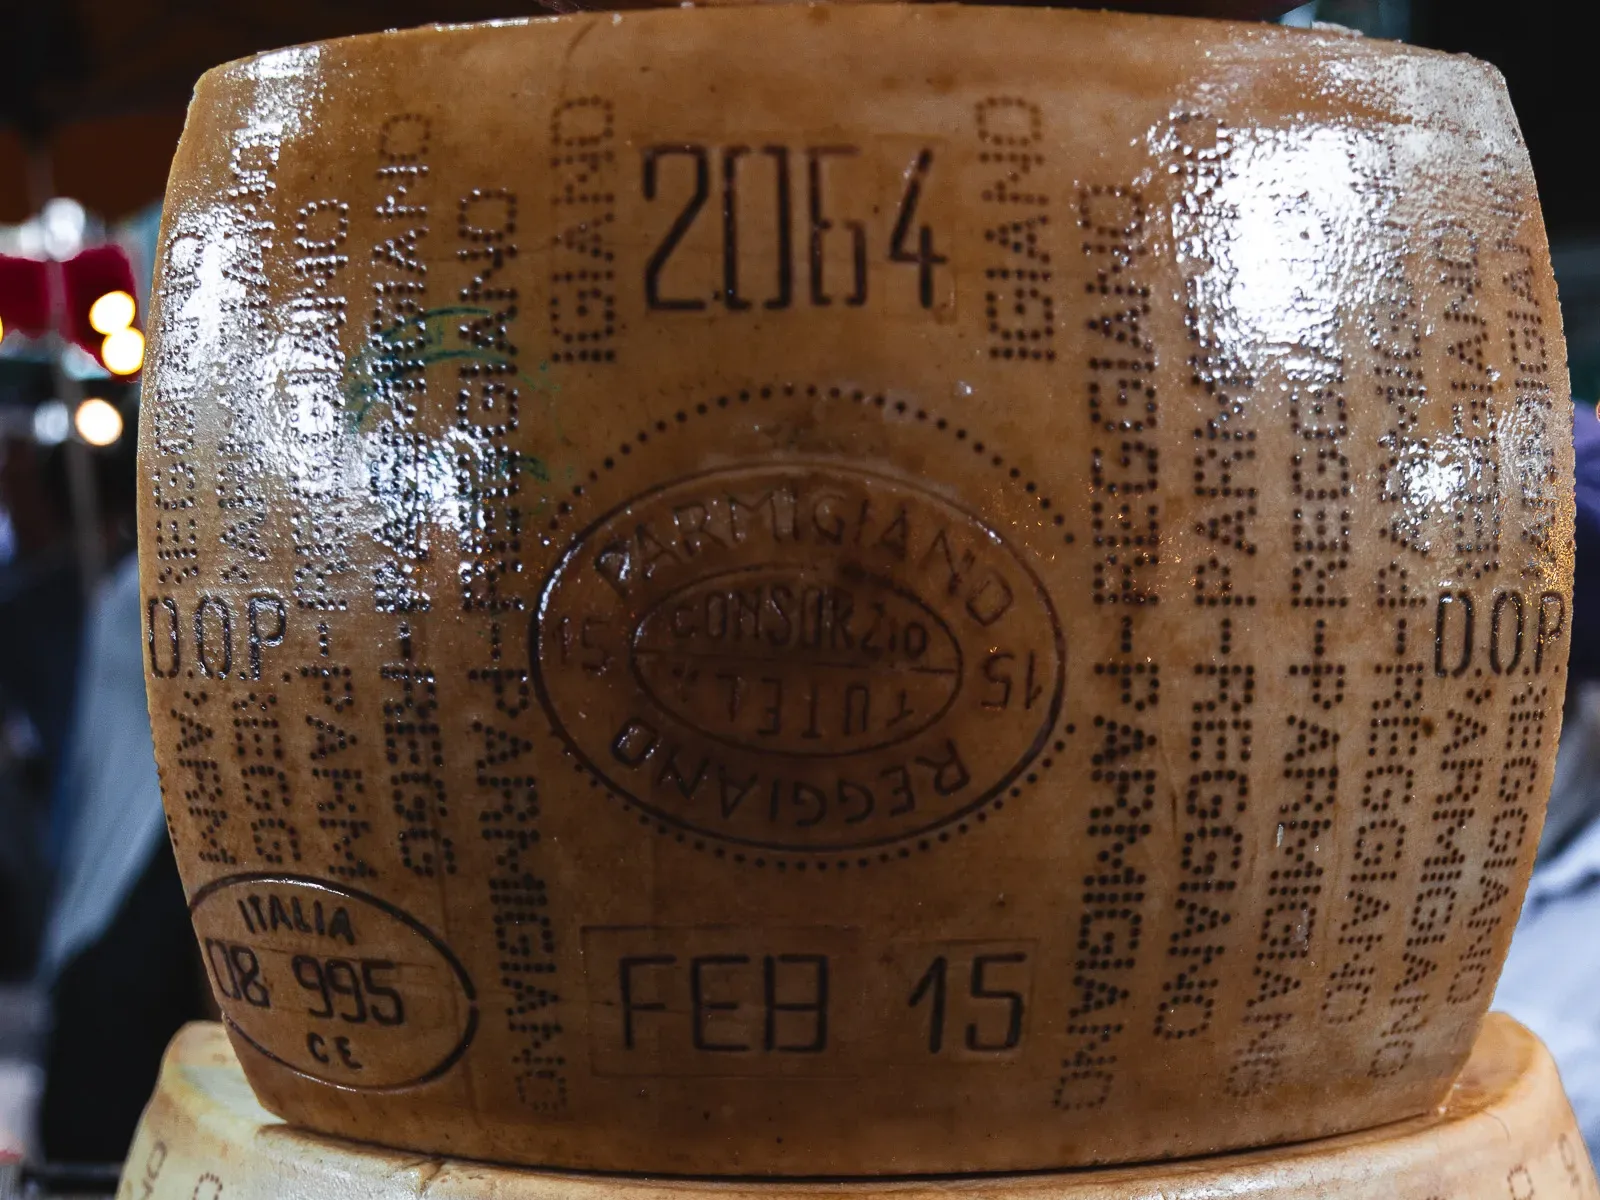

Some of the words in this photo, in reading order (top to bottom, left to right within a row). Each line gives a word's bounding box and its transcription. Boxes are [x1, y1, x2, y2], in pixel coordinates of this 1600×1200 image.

[1075, 183, 1160, 606] REGGIANO
[595, 486, 1014, 626] PARMIGIANO
[672, 581, 930, 661] CONSORZIO
[980, 648, 1043, 711] 15
[611, 716, 971, 828] REGGIANO
[467, 667, 568, 1113] PARMIGIANO
[1053, 662, 1160, 1110] PARMIGIANO
[1153, 662, 1255, 1041] REGGIANO
[1225, 662, 1345, 1099] PARMIGIANO
[1320, 662, 1424, 1026] REGGIANO
[240, 898, 357, 946] ITALIA
[290, 953, 407, 1027] 995
[619, 955, 830, 1053] FEB
[907, 953, 1027, 1054] 15
